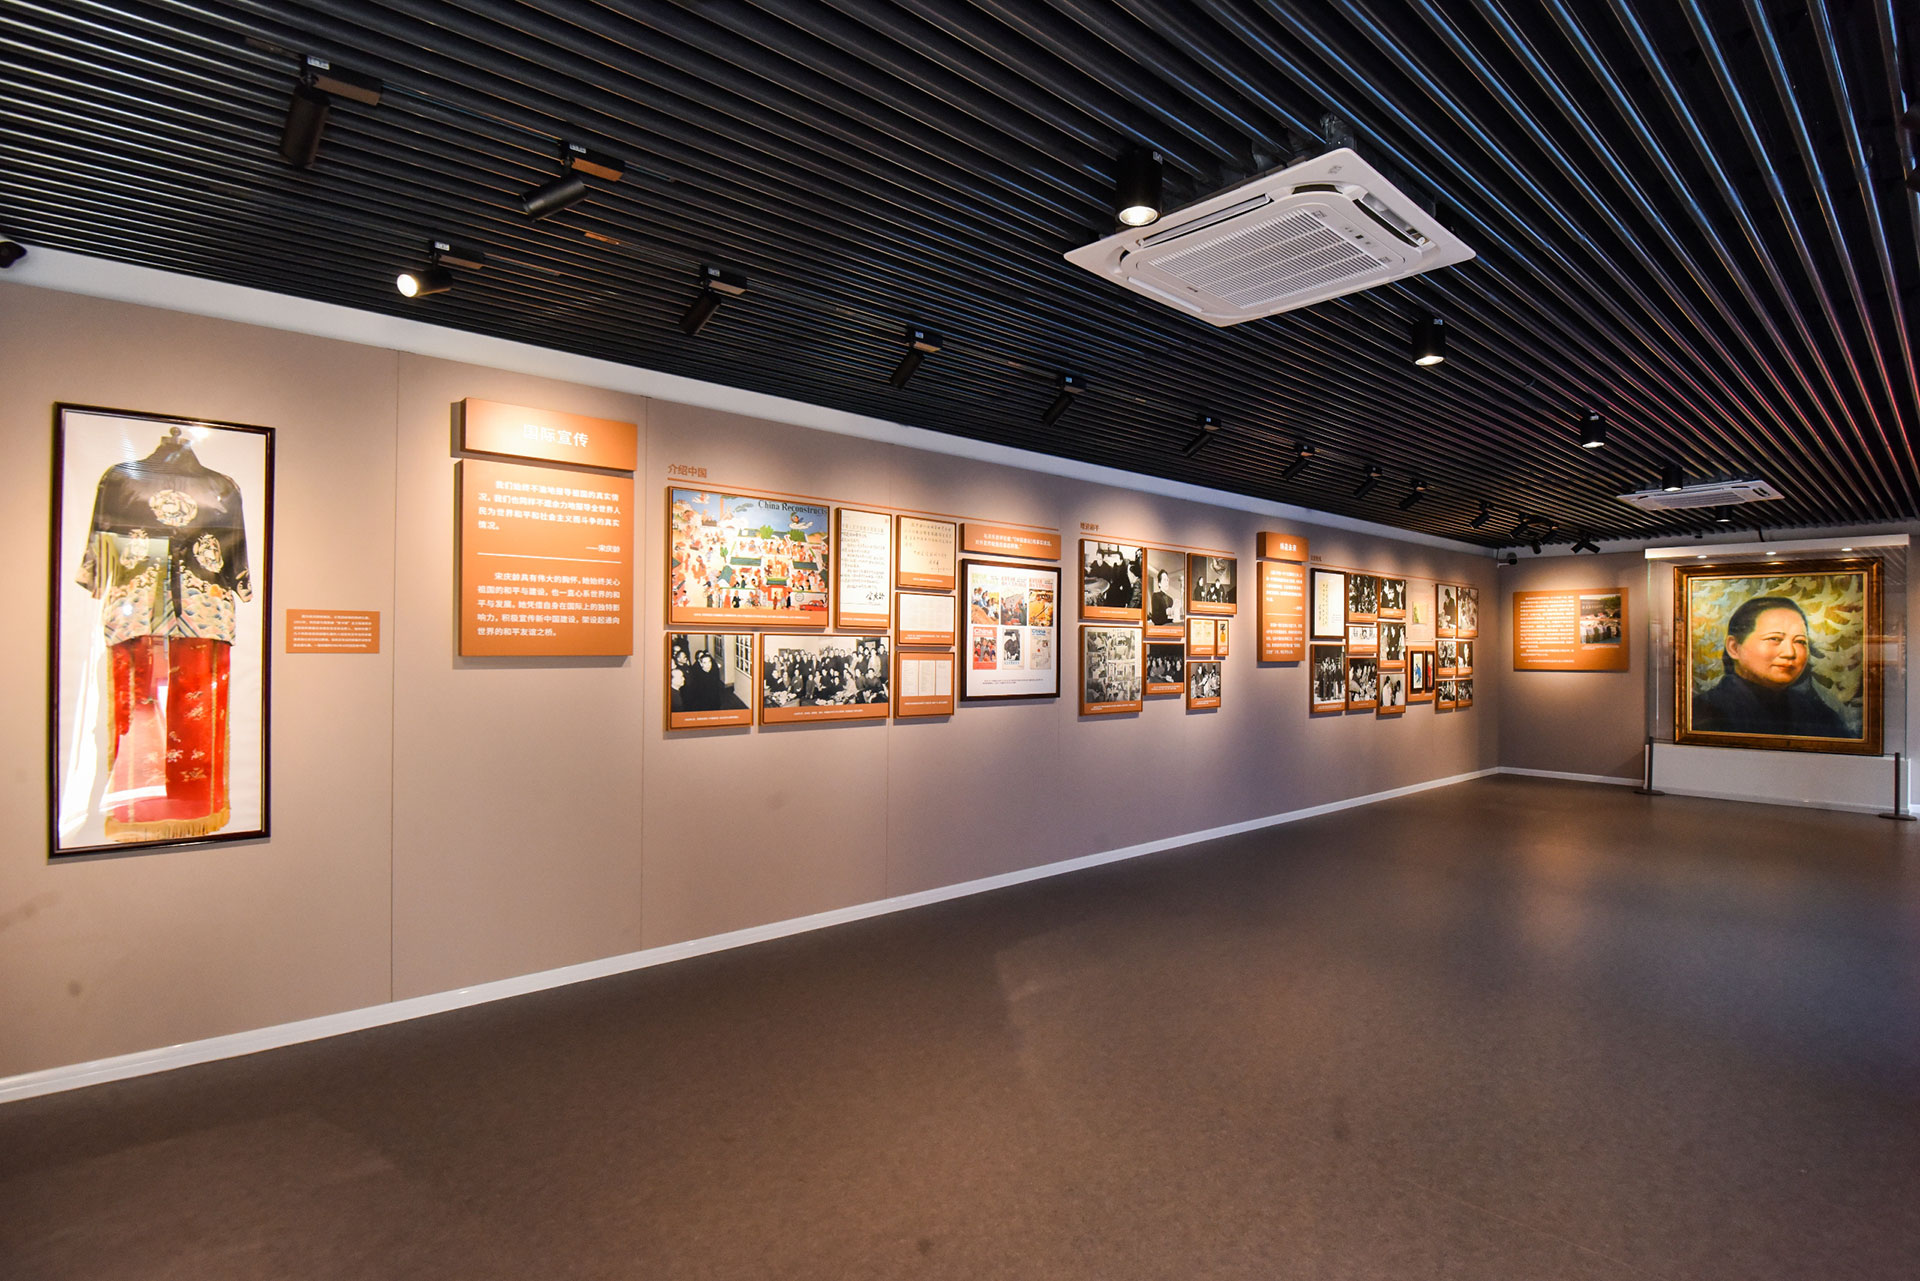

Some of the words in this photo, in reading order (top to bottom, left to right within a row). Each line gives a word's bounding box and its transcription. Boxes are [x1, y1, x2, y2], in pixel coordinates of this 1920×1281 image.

[523, 424, 589, 447] 国际宣传
[668, 463, 707, 478] 介绍中国
[758, 500, 780, 510] China
[781, 502, 828, 515] Reconstructs
